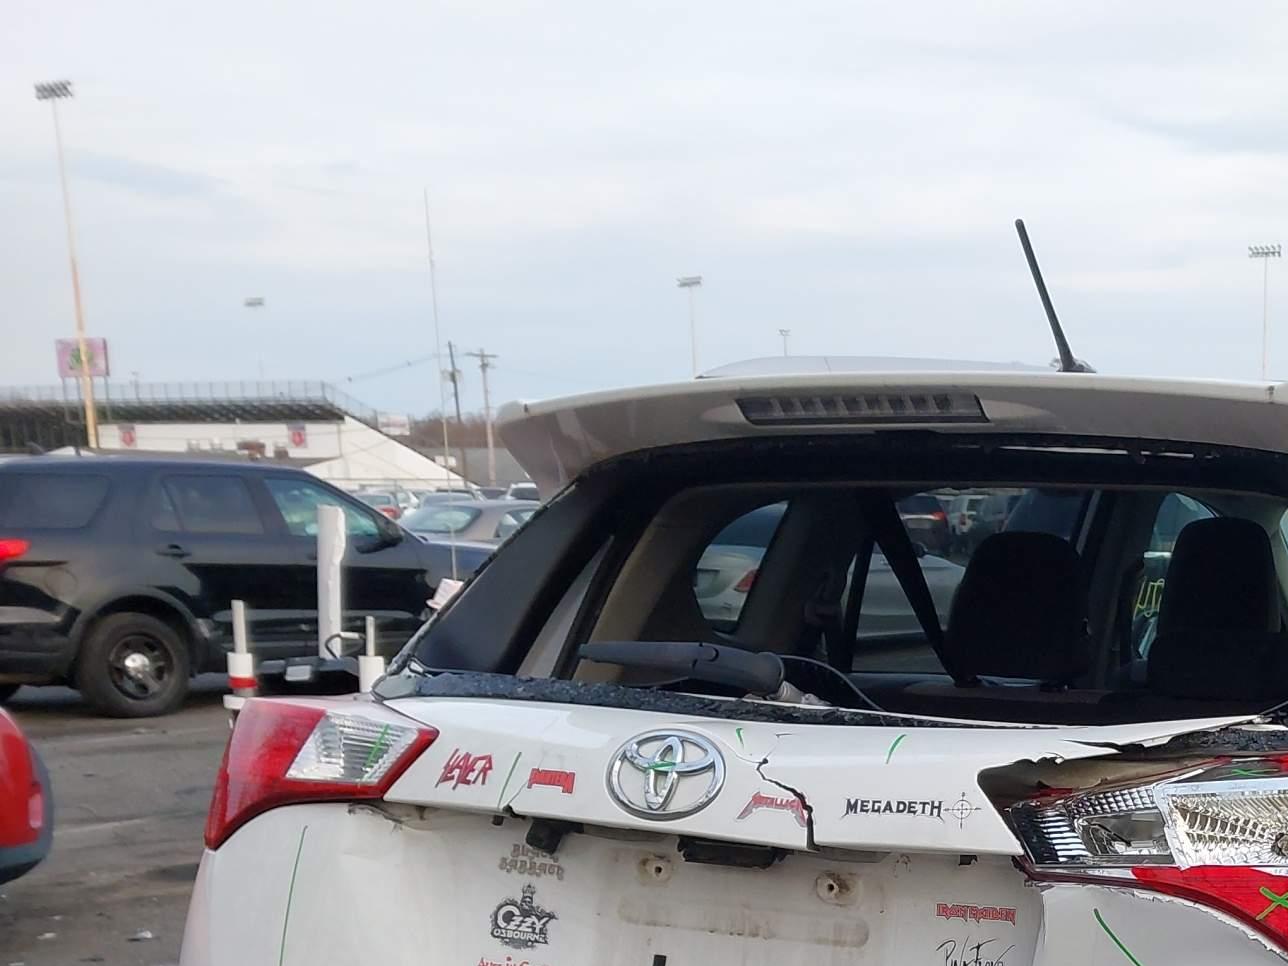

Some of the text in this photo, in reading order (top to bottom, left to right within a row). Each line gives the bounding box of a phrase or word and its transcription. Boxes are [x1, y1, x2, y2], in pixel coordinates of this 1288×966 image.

[840, 798, 945, 824] MEGADETH
[497, 904, 550, 932] OZZY
[936, 903, 1016, 927] IRON MAIDEN
[493, 928, 548, 943] OSBOURNE
